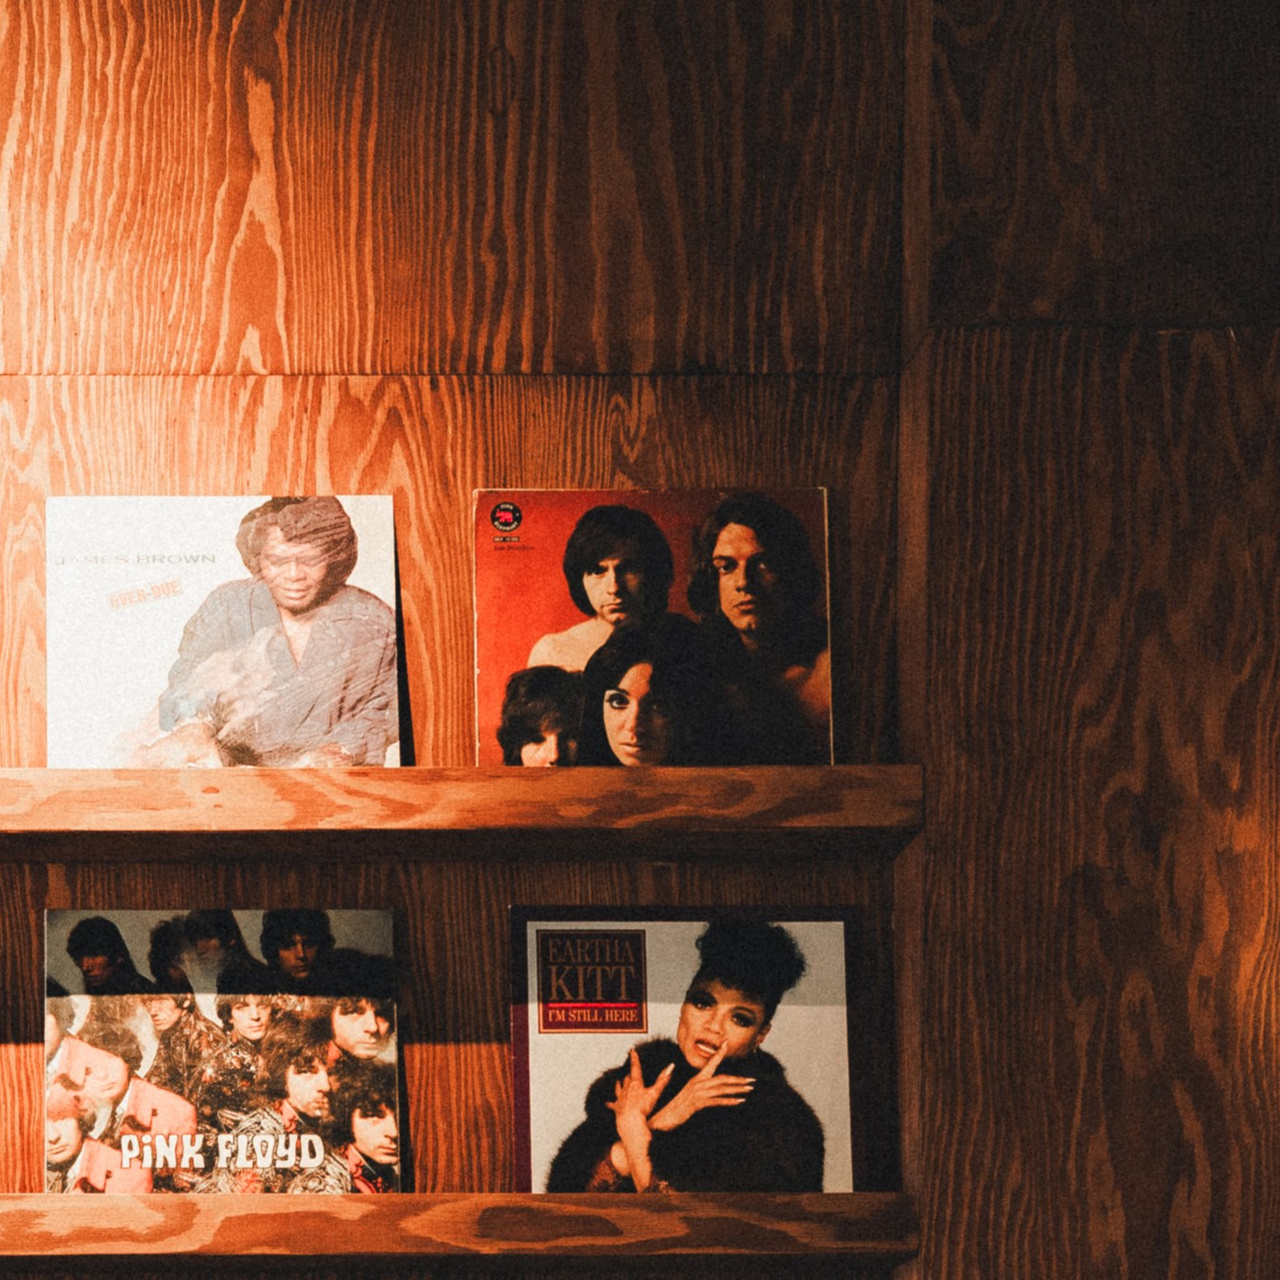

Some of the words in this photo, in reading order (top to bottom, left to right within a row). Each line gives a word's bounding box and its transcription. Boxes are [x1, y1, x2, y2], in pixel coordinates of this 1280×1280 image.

[136, 554, 217, 564] BROWN
[548, 939, 635, 962] EARTHA
[547, 965, 636, 1000] KITT
[548, 1009, 566, 1021] I'M
[568, 1009, 602, 1022] STILL
[604, 1009, 638, 1022] HERE
[217, 1133, 325, 1169] FLOYD
